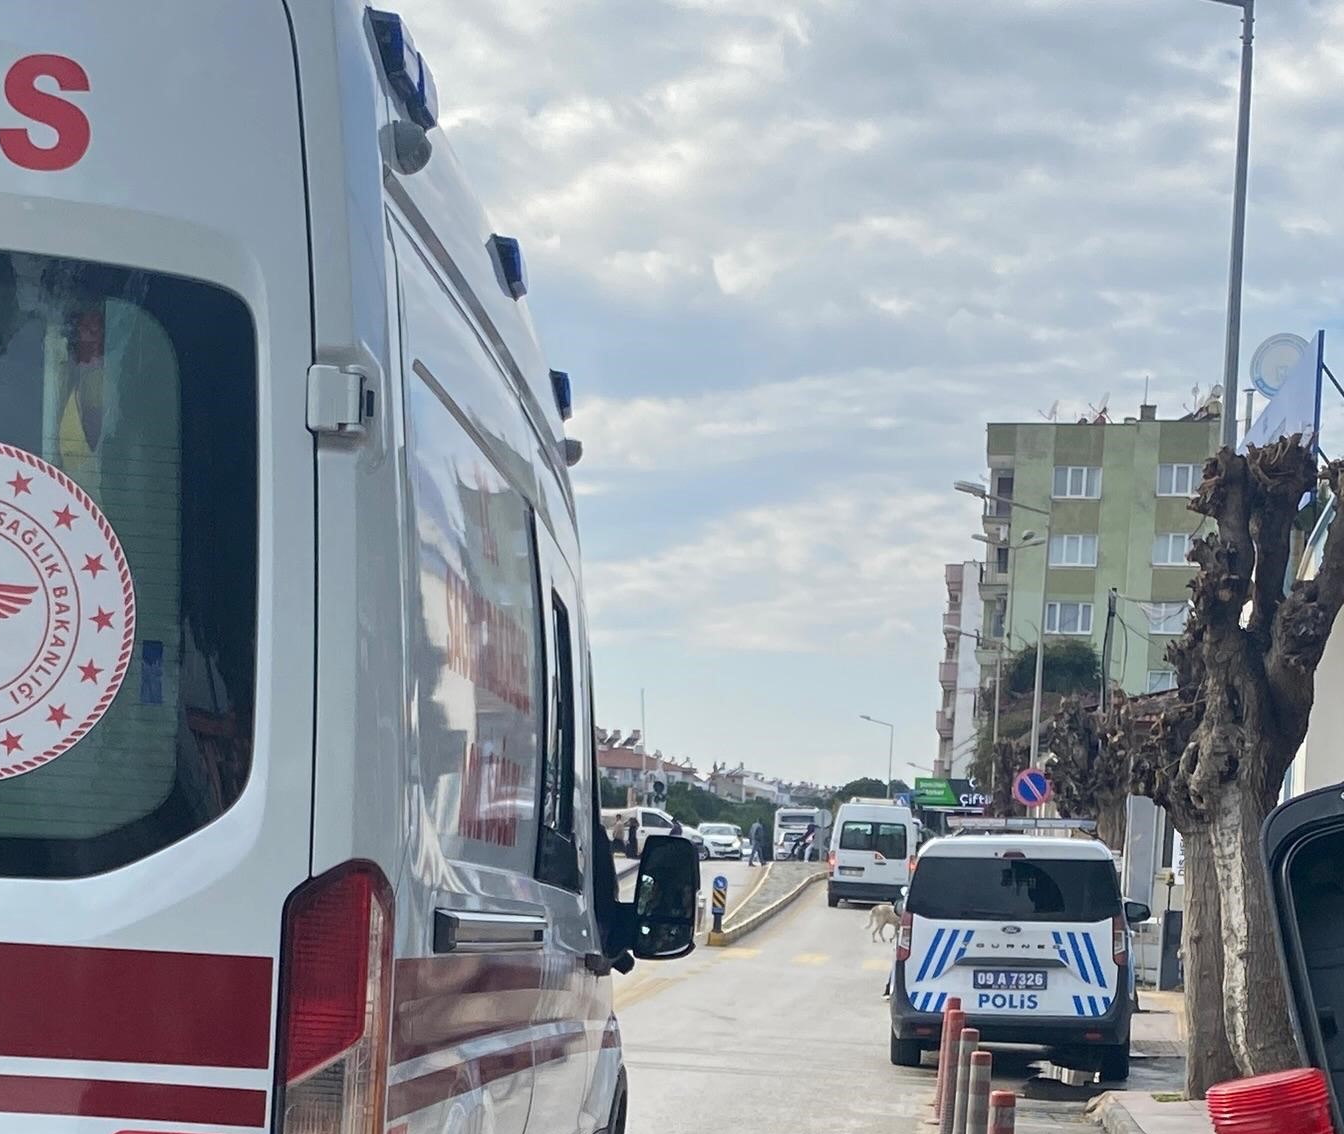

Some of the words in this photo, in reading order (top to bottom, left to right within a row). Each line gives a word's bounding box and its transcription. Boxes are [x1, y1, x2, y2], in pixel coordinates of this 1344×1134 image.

[9, 585, 71, 704] BAKANLIĞI
[977, 973, 994, 985] 09
[997, 973, 1007, 985] A
[1010, 973, 1043, 986] 7326
[979, 993, 1038, 1009] POLİS
